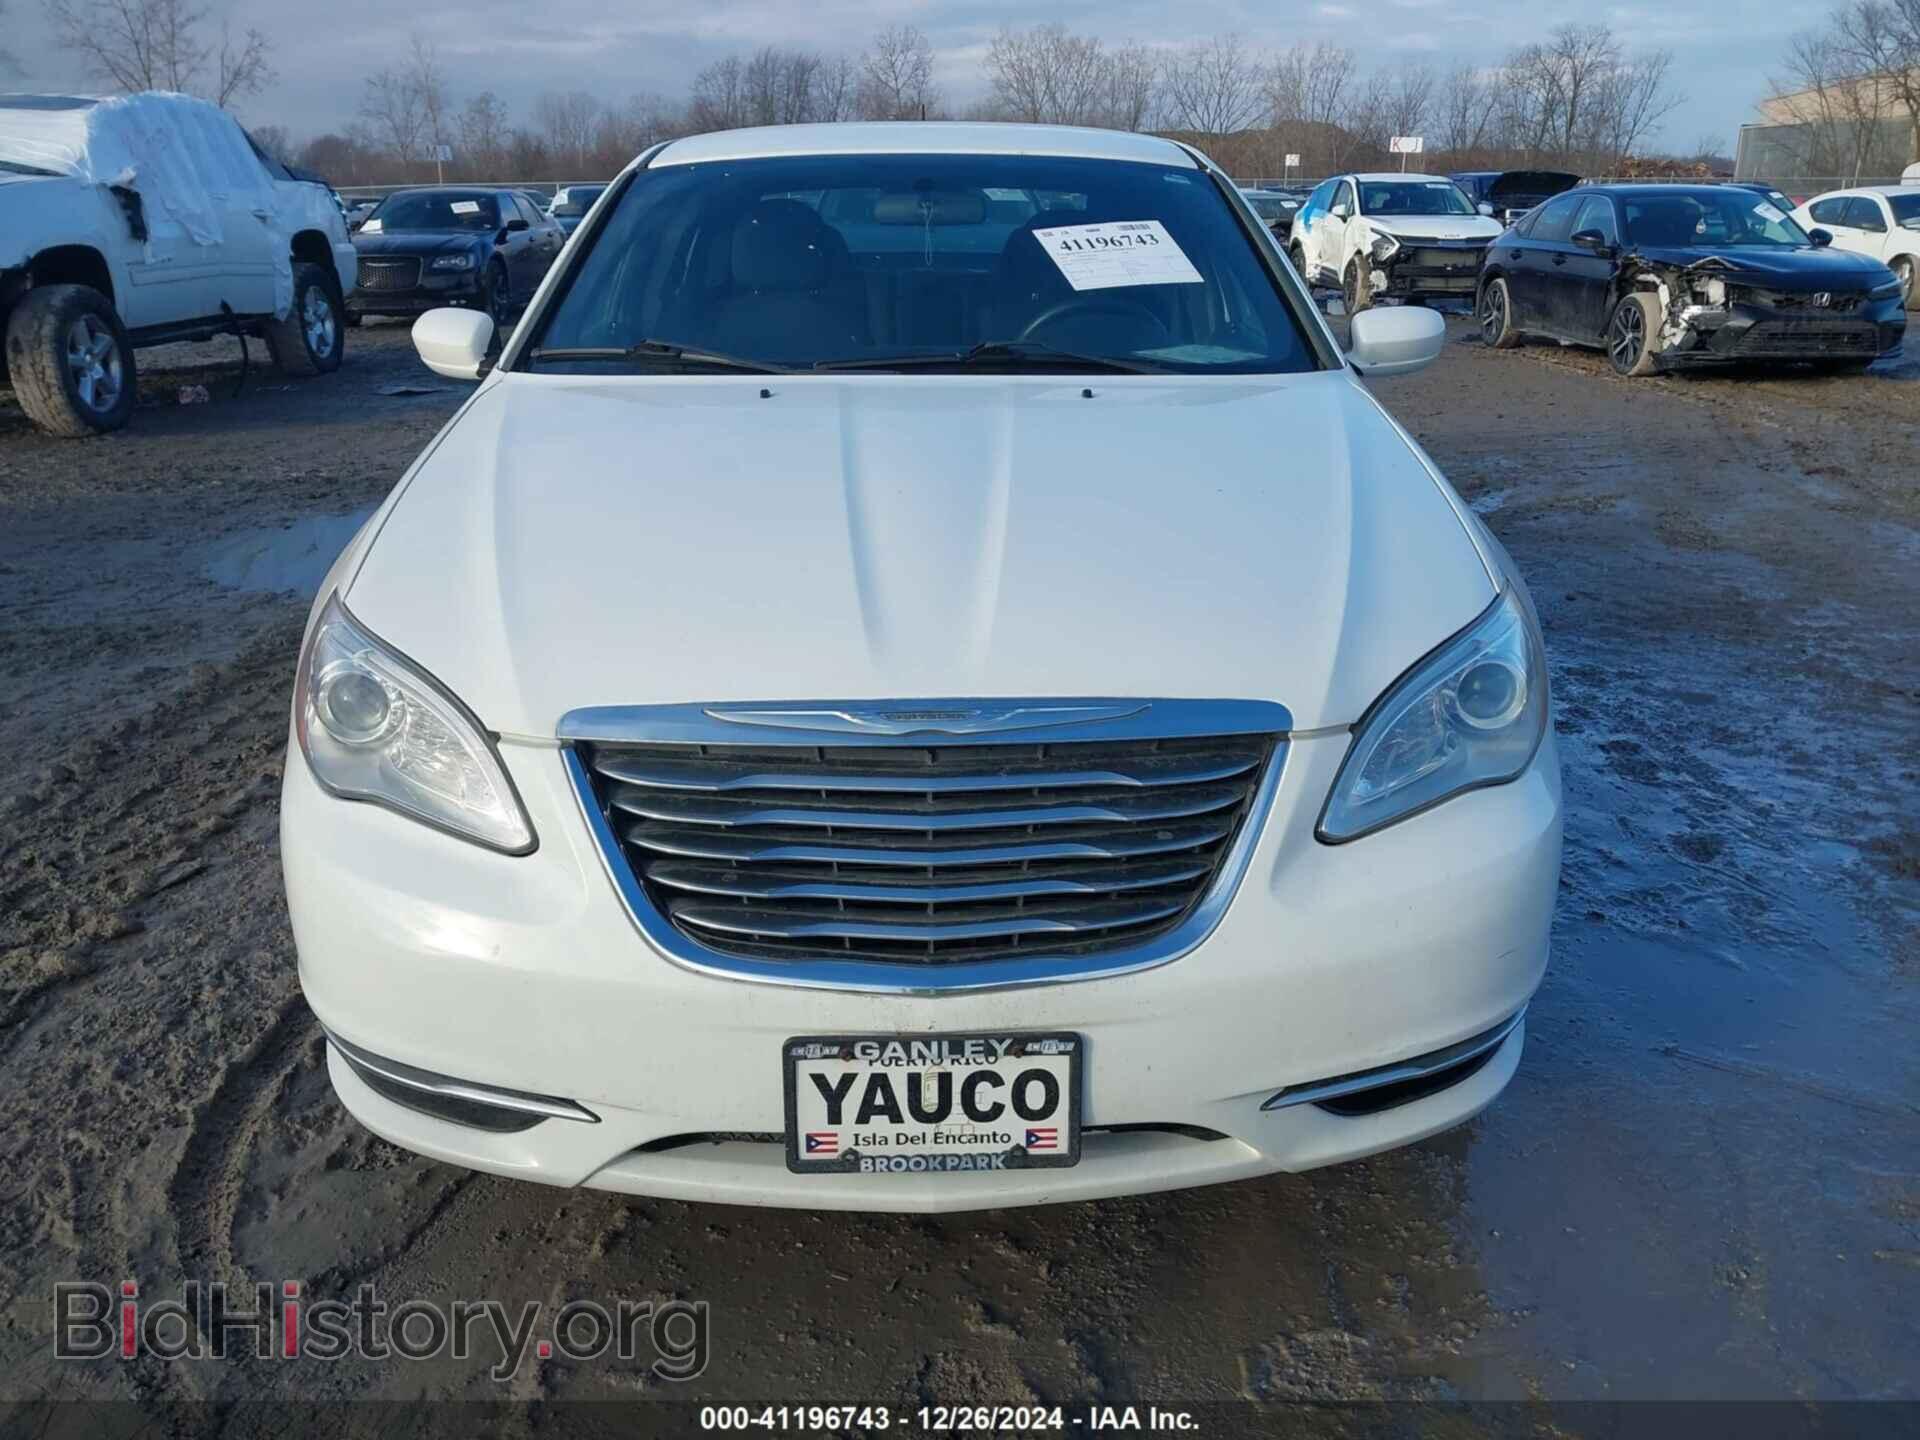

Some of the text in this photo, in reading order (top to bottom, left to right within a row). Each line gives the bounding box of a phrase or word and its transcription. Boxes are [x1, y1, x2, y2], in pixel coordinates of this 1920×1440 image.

[1060, 233, 1160, 252] 41196743
[854, 1037, 1014, 1060] GANLEY
[808, 1068, 1060, 1125] YAUCO
[853, 1131, 1012, 1147] Isla Del Encanto
